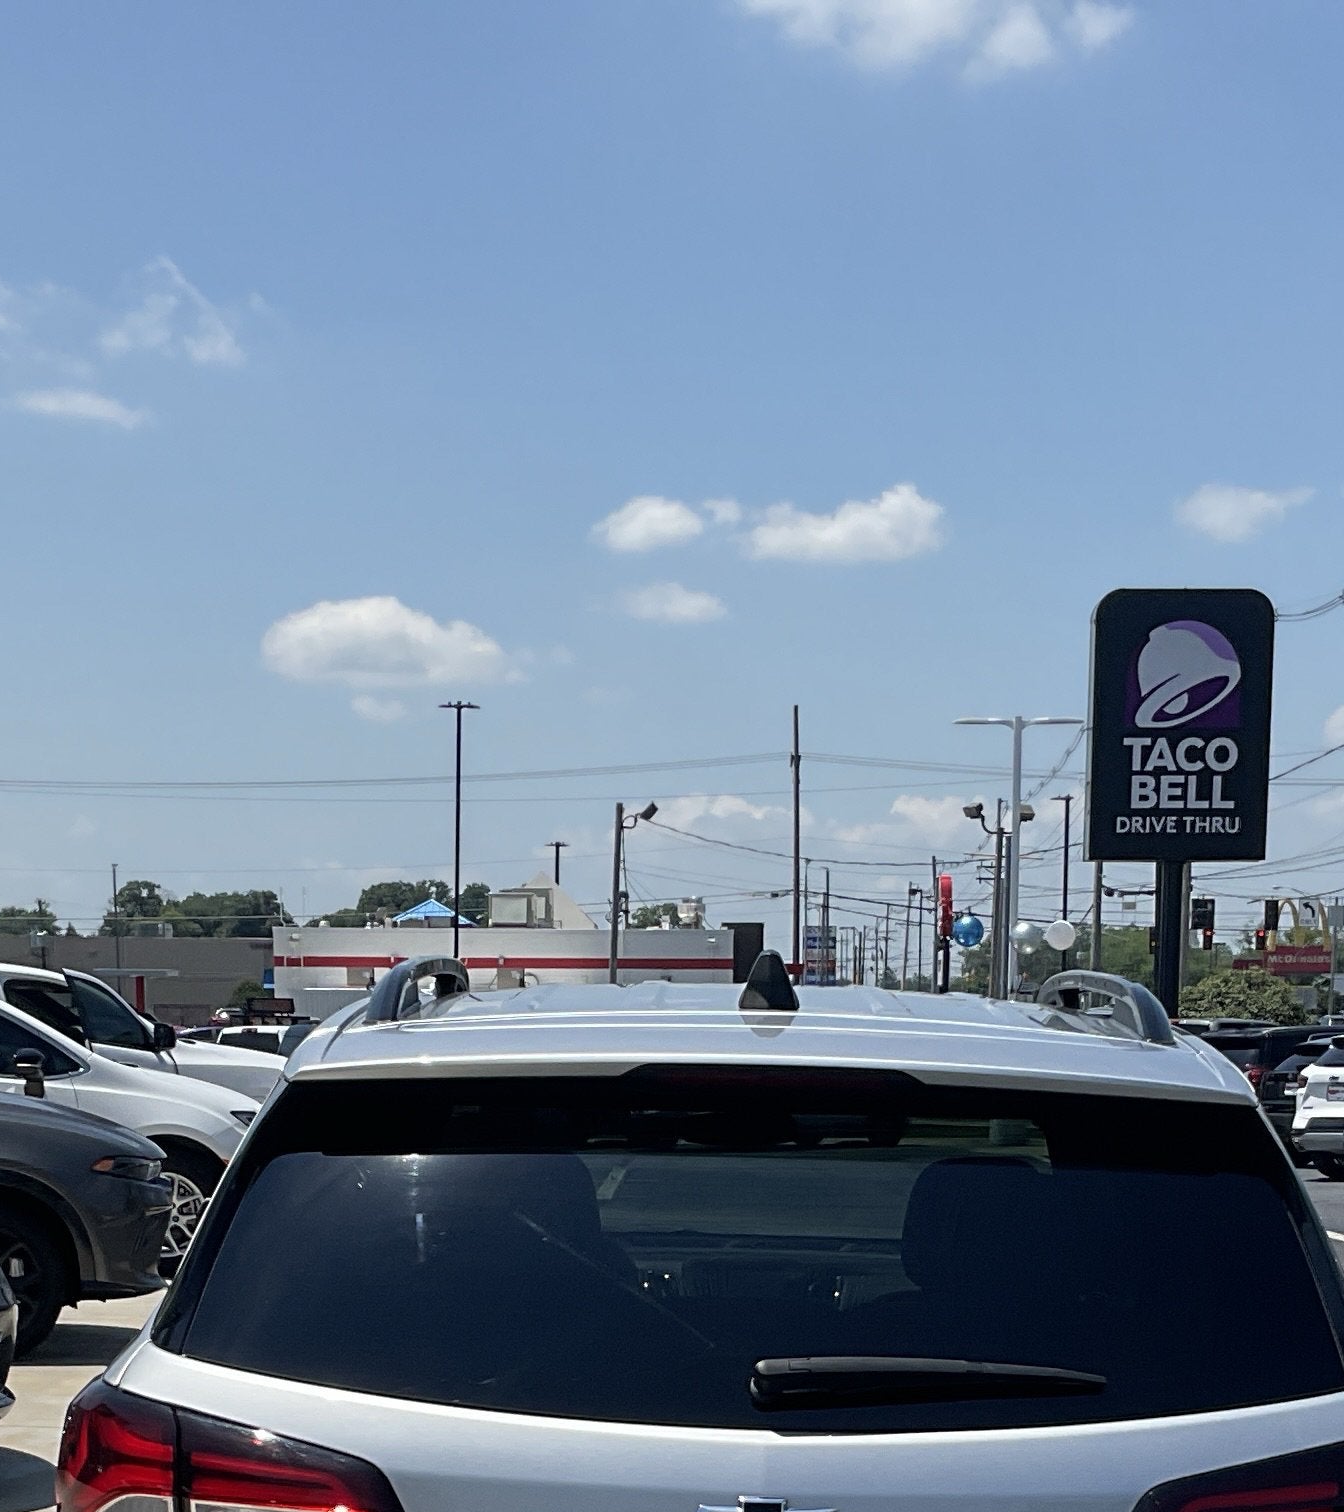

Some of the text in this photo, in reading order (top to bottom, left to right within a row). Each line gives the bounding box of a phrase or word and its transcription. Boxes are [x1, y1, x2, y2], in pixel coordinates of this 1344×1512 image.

[1123, 737, 1239, 772] TACO
[1130, 775, 1235, 809] BELL
[1116, 816, 1242, 834] DRIVE THRU
